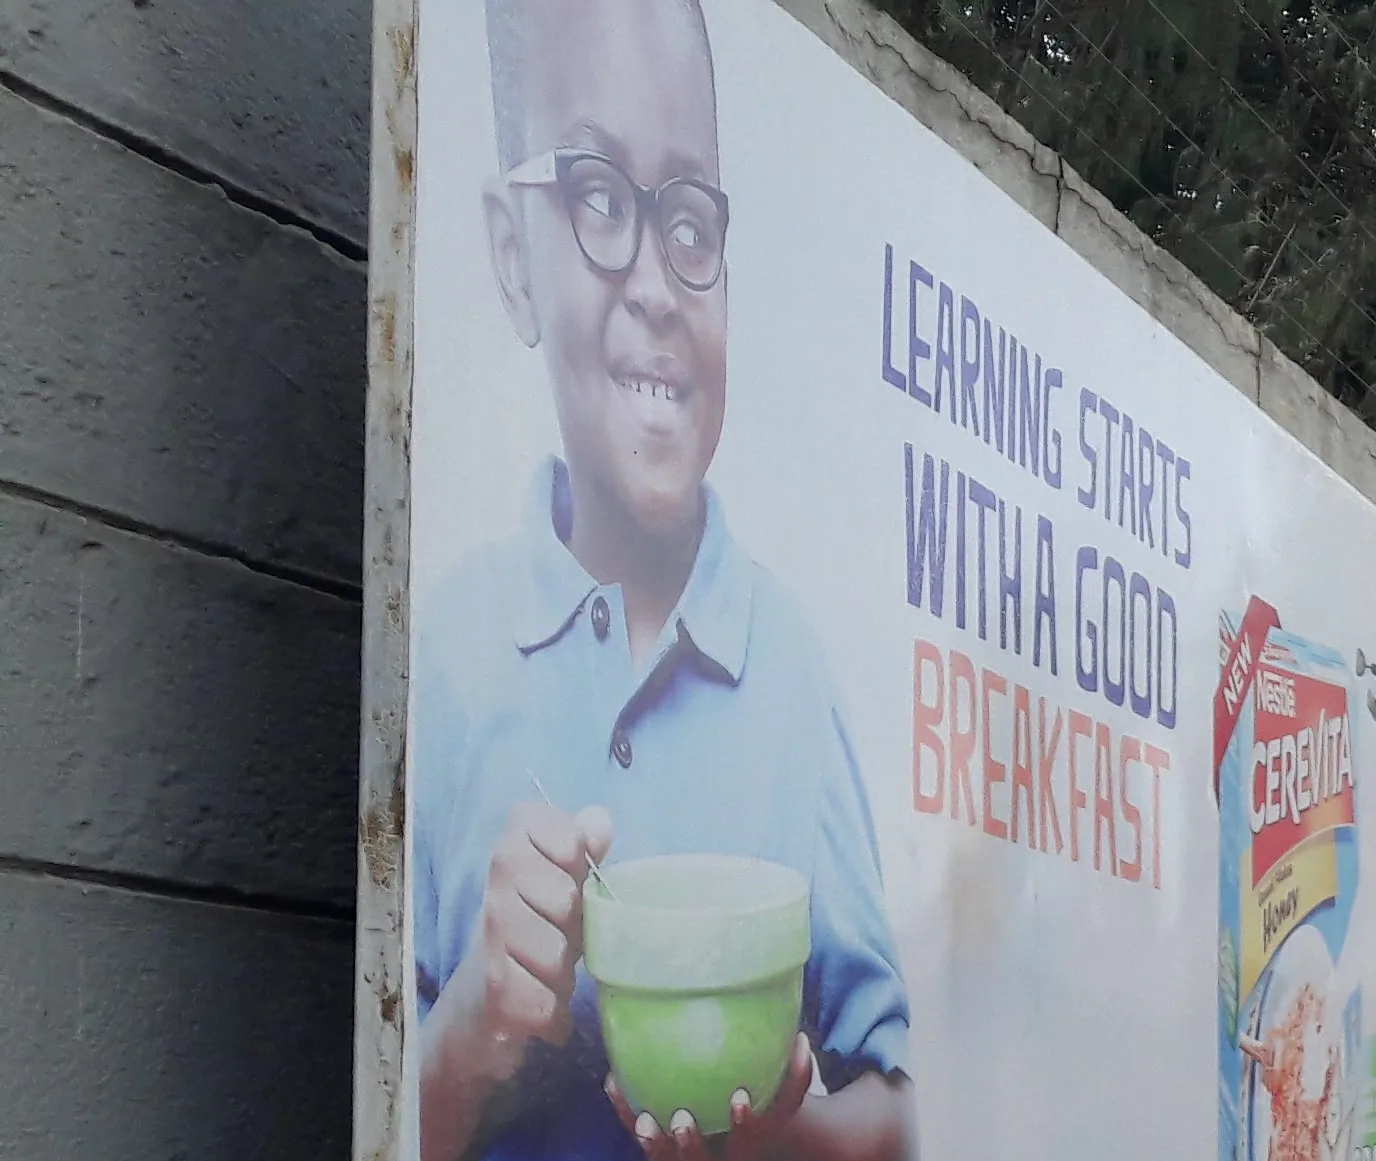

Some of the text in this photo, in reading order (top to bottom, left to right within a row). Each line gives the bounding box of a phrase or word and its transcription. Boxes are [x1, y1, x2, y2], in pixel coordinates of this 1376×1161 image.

[882, 242, 1191, 570] LEARNING STARTS
[904, 442, 1178, 730] WITH A GOOD
[1222, 632, 1253, 717] NEW
[913, 638, 1170, 890] BREAKFAST
[1250, 707, 1354, 834] CEREVITA
